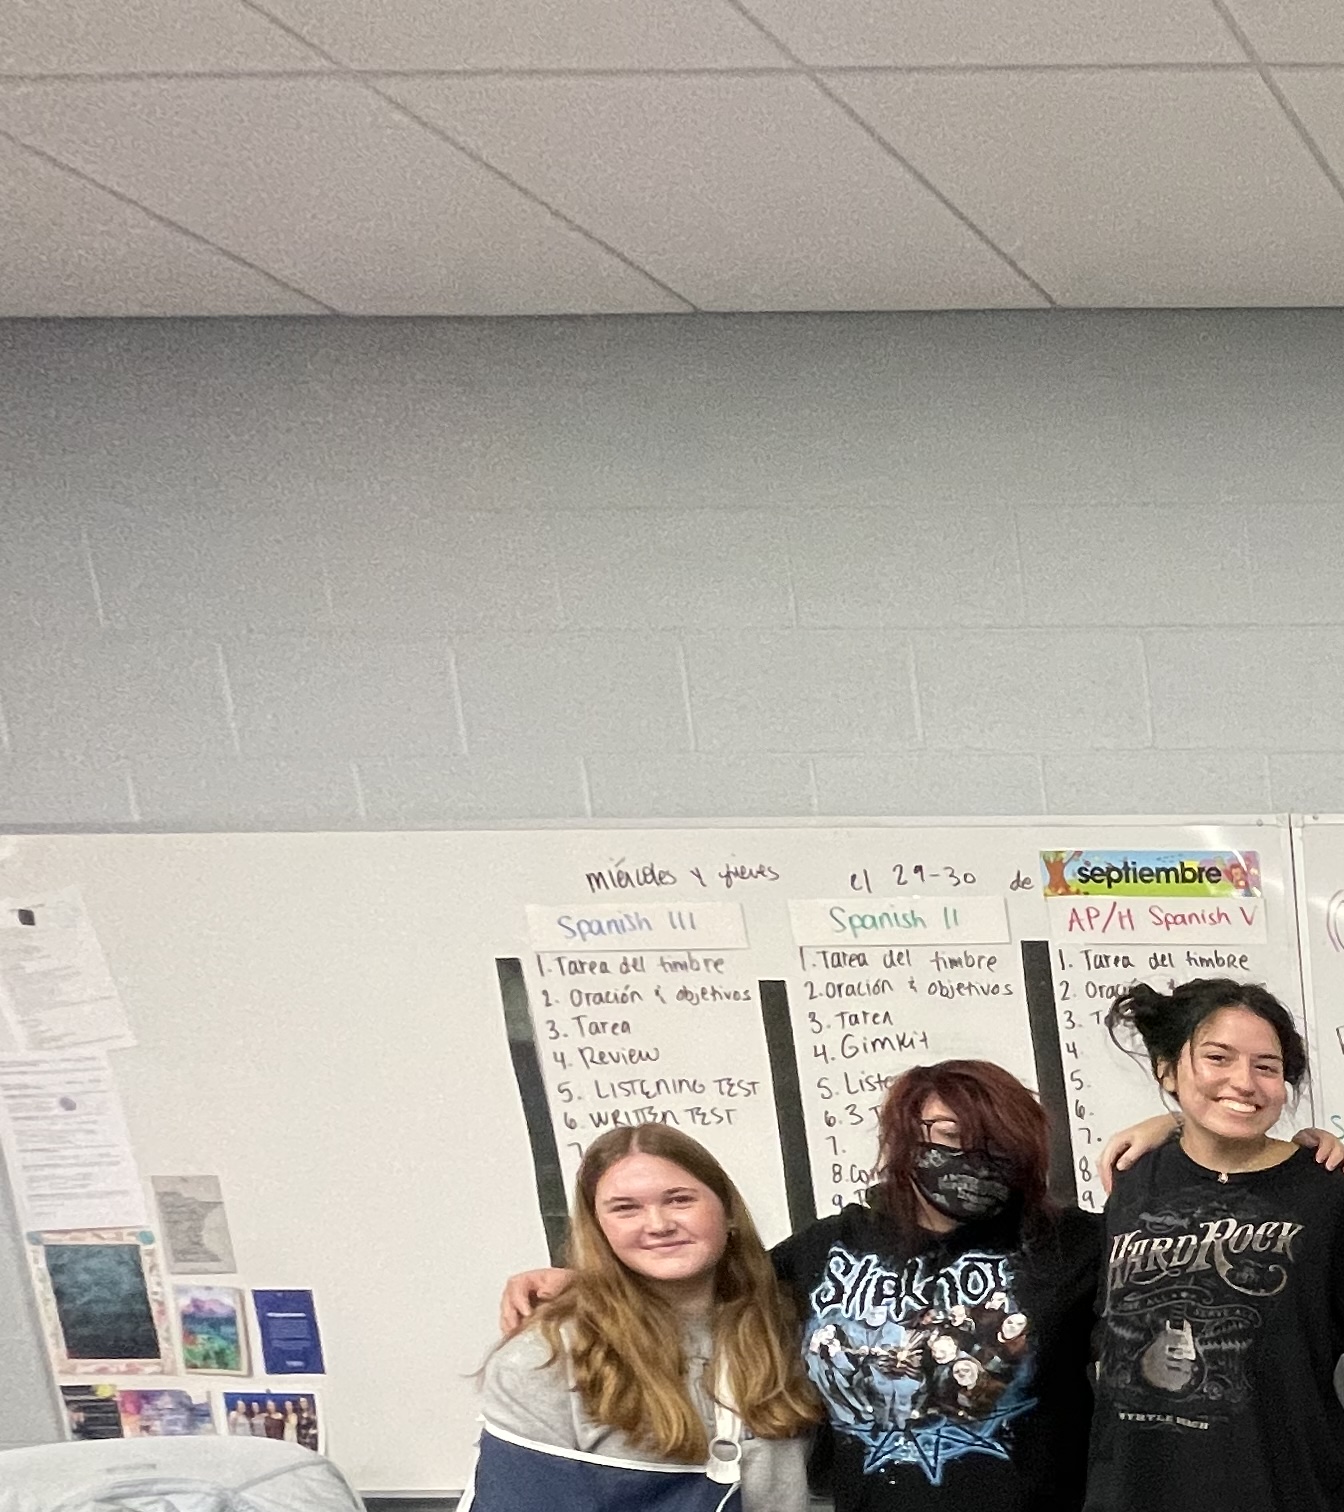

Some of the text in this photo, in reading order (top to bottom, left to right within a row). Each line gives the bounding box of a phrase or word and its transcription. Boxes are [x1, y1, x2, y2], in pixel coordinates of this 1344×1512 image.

[1010, 870, 1035, 892] de
[1077, 861, 1222, 888] septiembre
[557, 911, 653, 942] Spanish
[829, 906, 927, 938] Spanish
[1149, 905, 1231, 931] Spanish
[1149, 950, 1174, 970] del
[577, 1045, 660, 1069] Review
[713, 1077, 761, 1098] TEST
[686, 1107, 738, 1126] TEST
[1104, 1218, 1304, 1290] HARD ROCK
